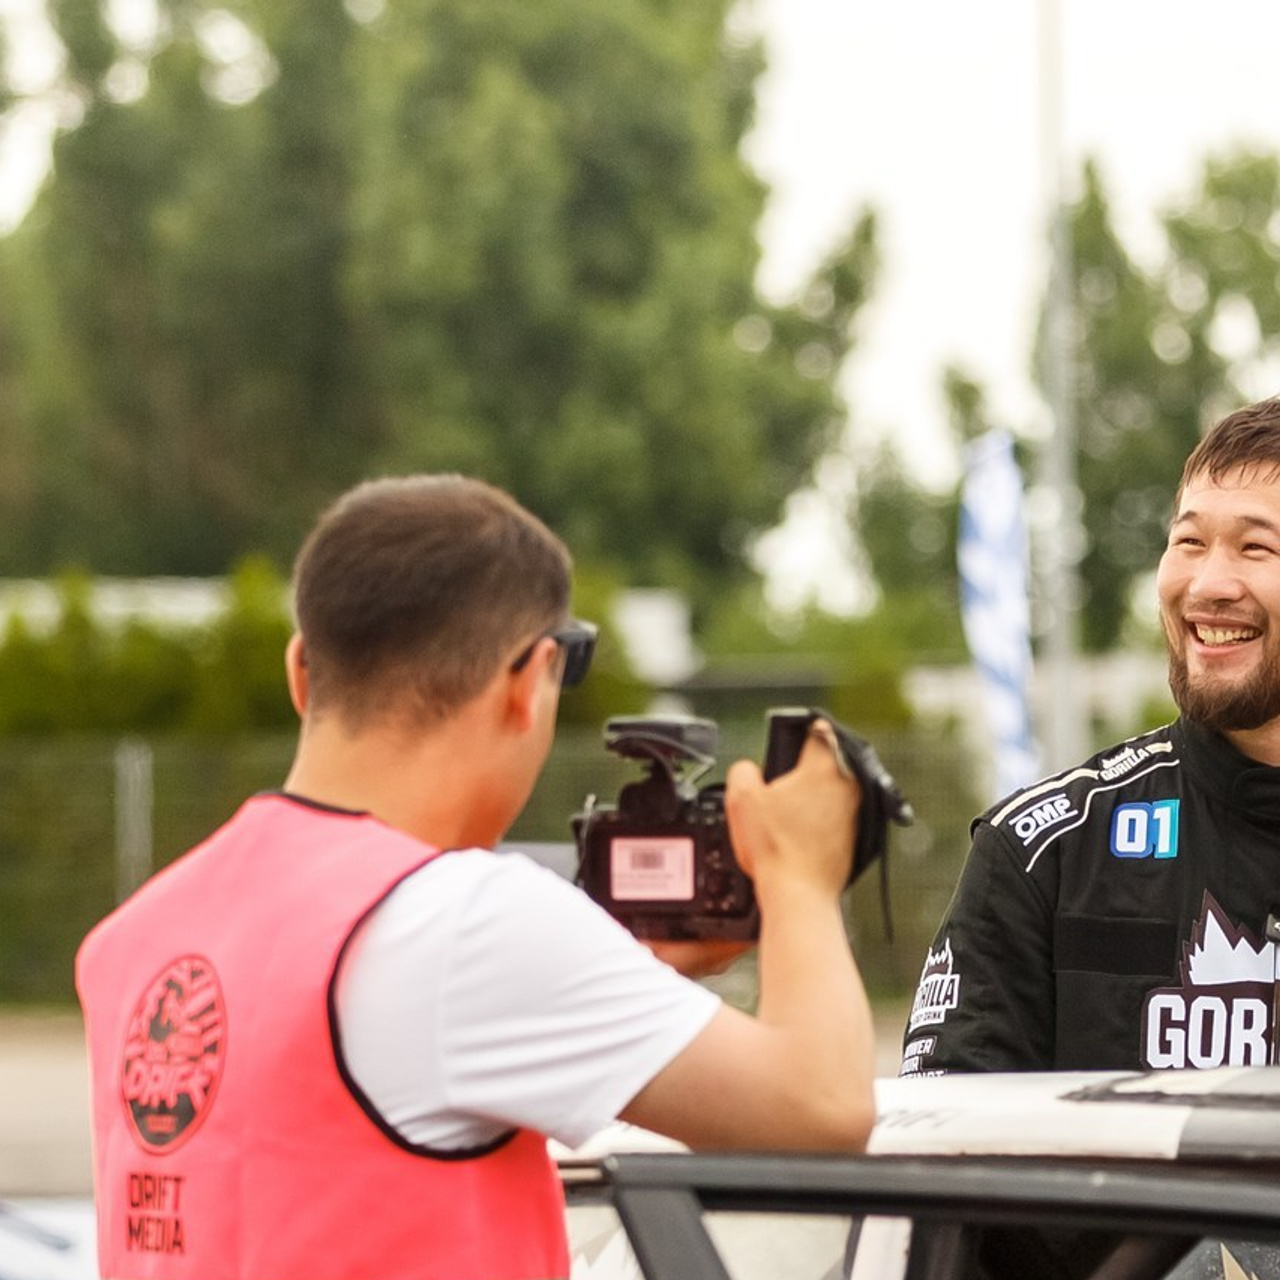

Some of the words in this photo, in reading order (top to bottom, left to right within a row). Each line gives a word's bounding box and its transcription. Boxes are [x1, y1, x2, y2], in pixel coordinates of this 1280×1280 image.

[1100, 747, 1150, 781] GORILLA
[1015, 798, 1071, 839] OMP
[1114, 804, 1175, 855] 01
[128, 1173, 185, 1213] DRIFT
[126, 1216, 187, 1255] MEDIA
